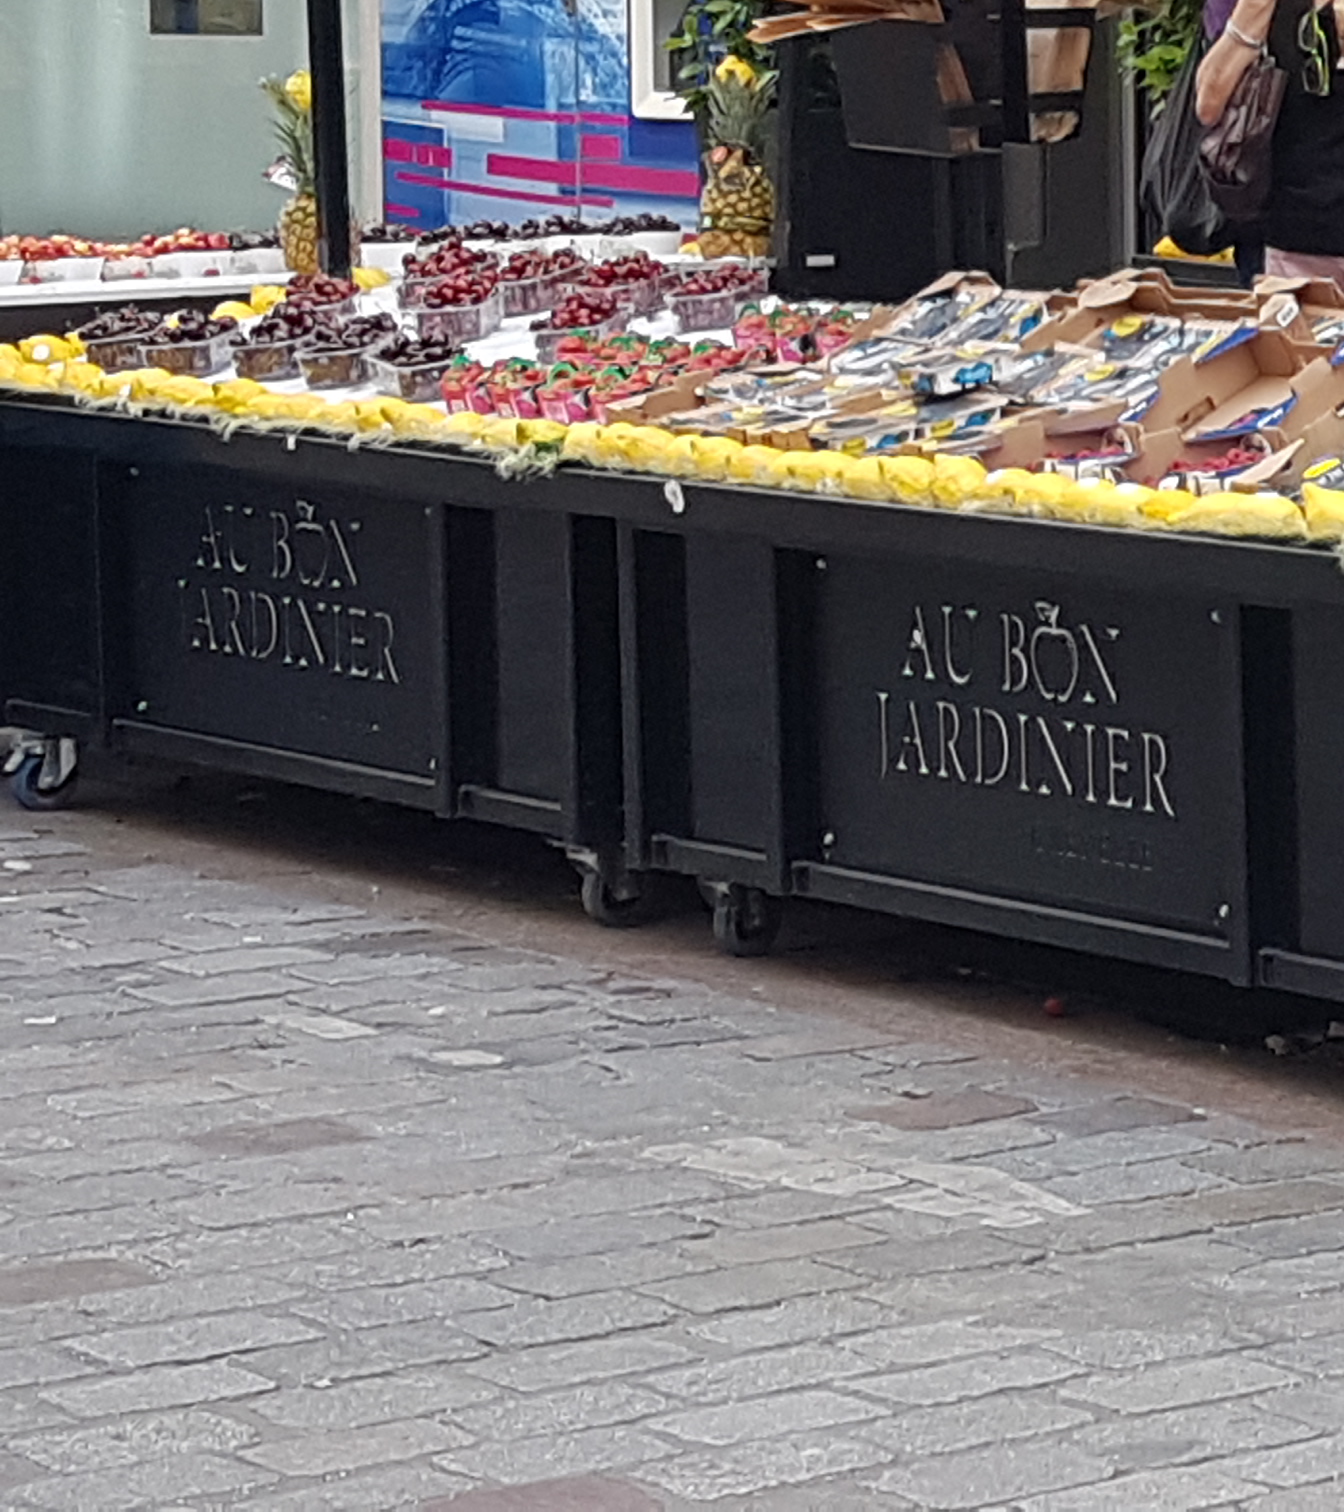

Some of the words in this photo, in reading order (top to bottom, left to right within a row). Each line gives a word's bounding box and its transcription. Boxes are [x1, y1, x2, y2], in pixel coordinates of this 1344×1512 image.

[196, 505, 254, 573] AU
[269, 499, 360, 587] BON
[901, 605, 979, 685] AU
[1000, 599, 1121, 705] BON
[876, 691, 1176, 818] JARDINIER
